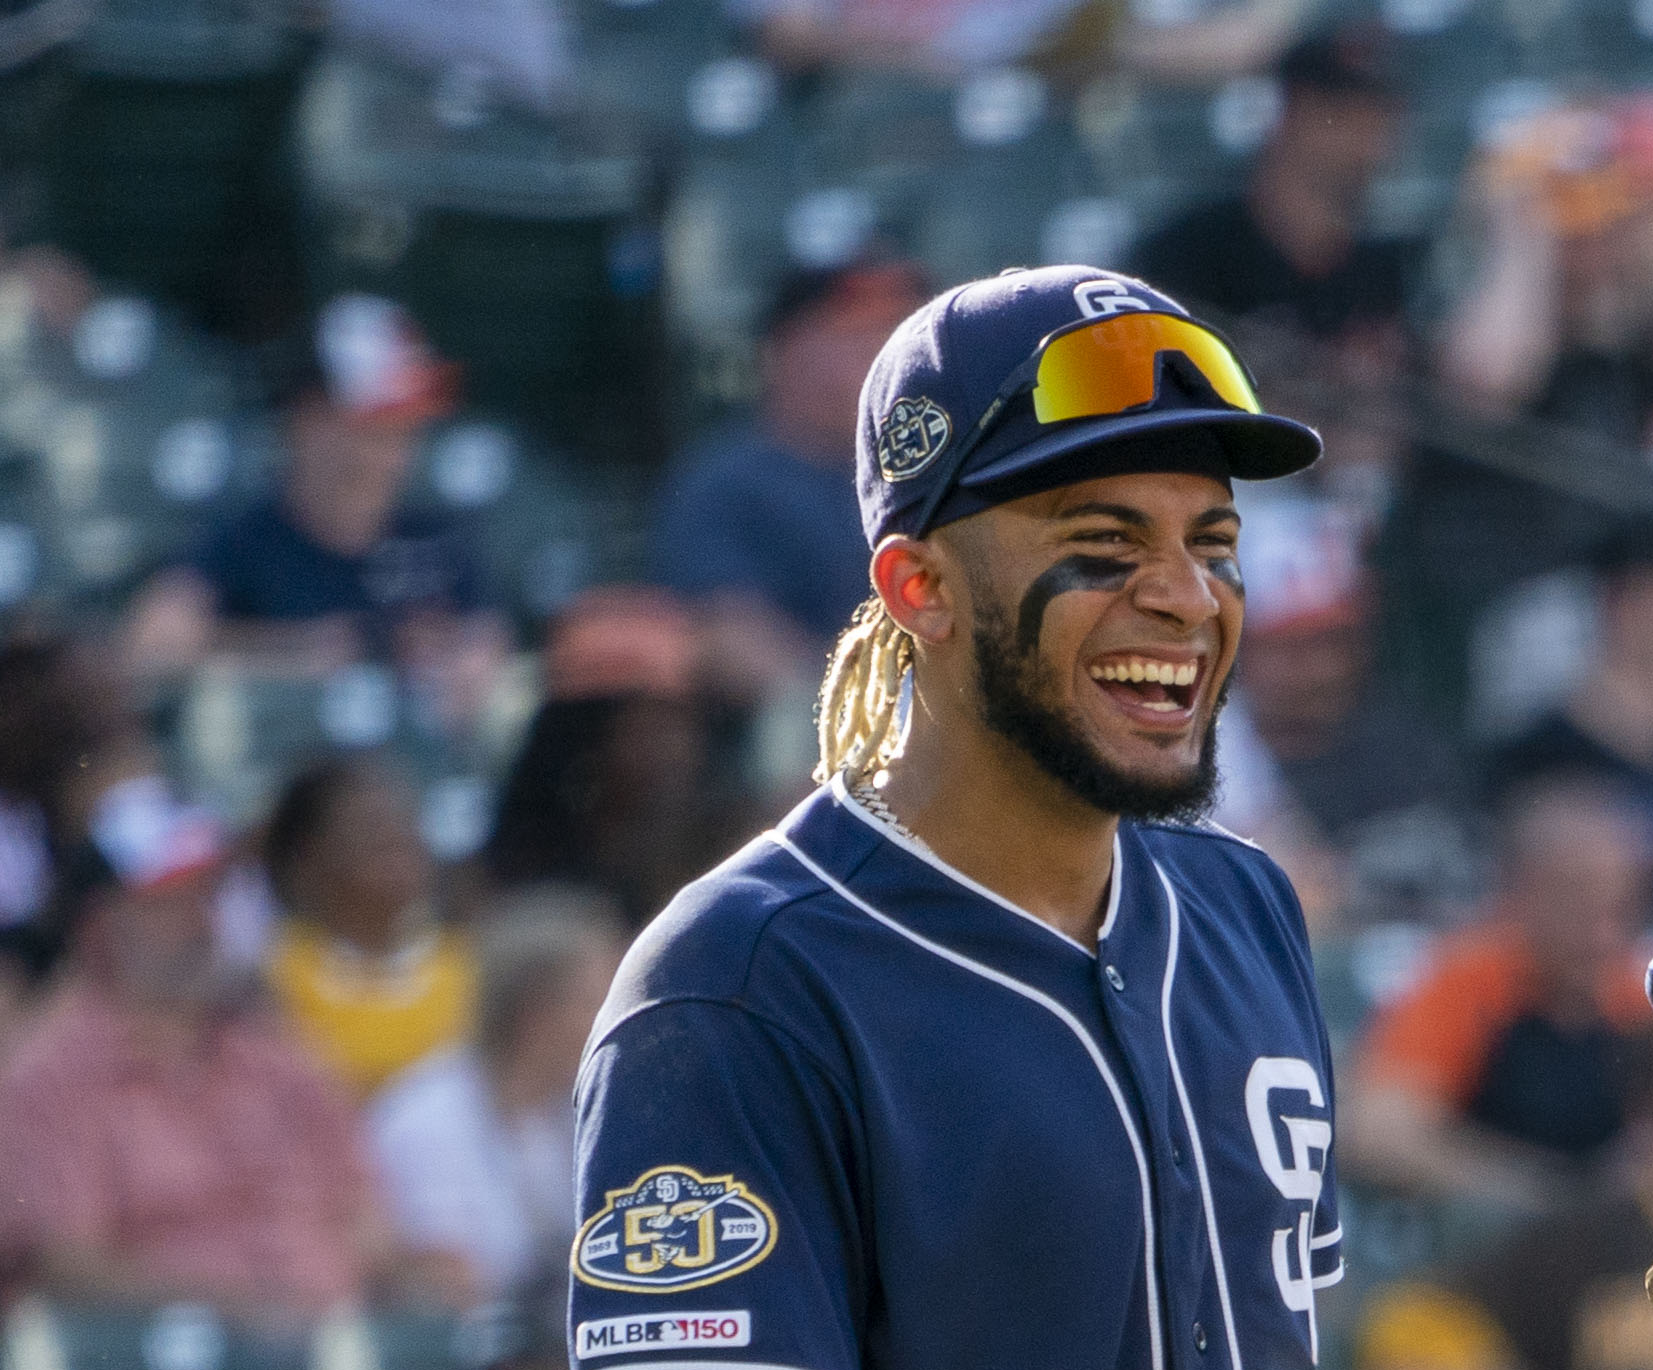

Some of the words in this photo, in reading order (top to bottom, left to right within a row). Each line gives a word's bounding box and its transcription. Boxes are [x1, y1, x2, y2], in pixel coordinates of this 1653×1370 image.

[656, 1175, 680, 1202] SD
[625, 1200, 716, 1274] 50
[728, 1223, 758, 1234] 2019
[587, 1241, 612, 1255] 1969
[586, 1322, 645, 1350] MLB
[689, 1318, 740, 1340] 150
